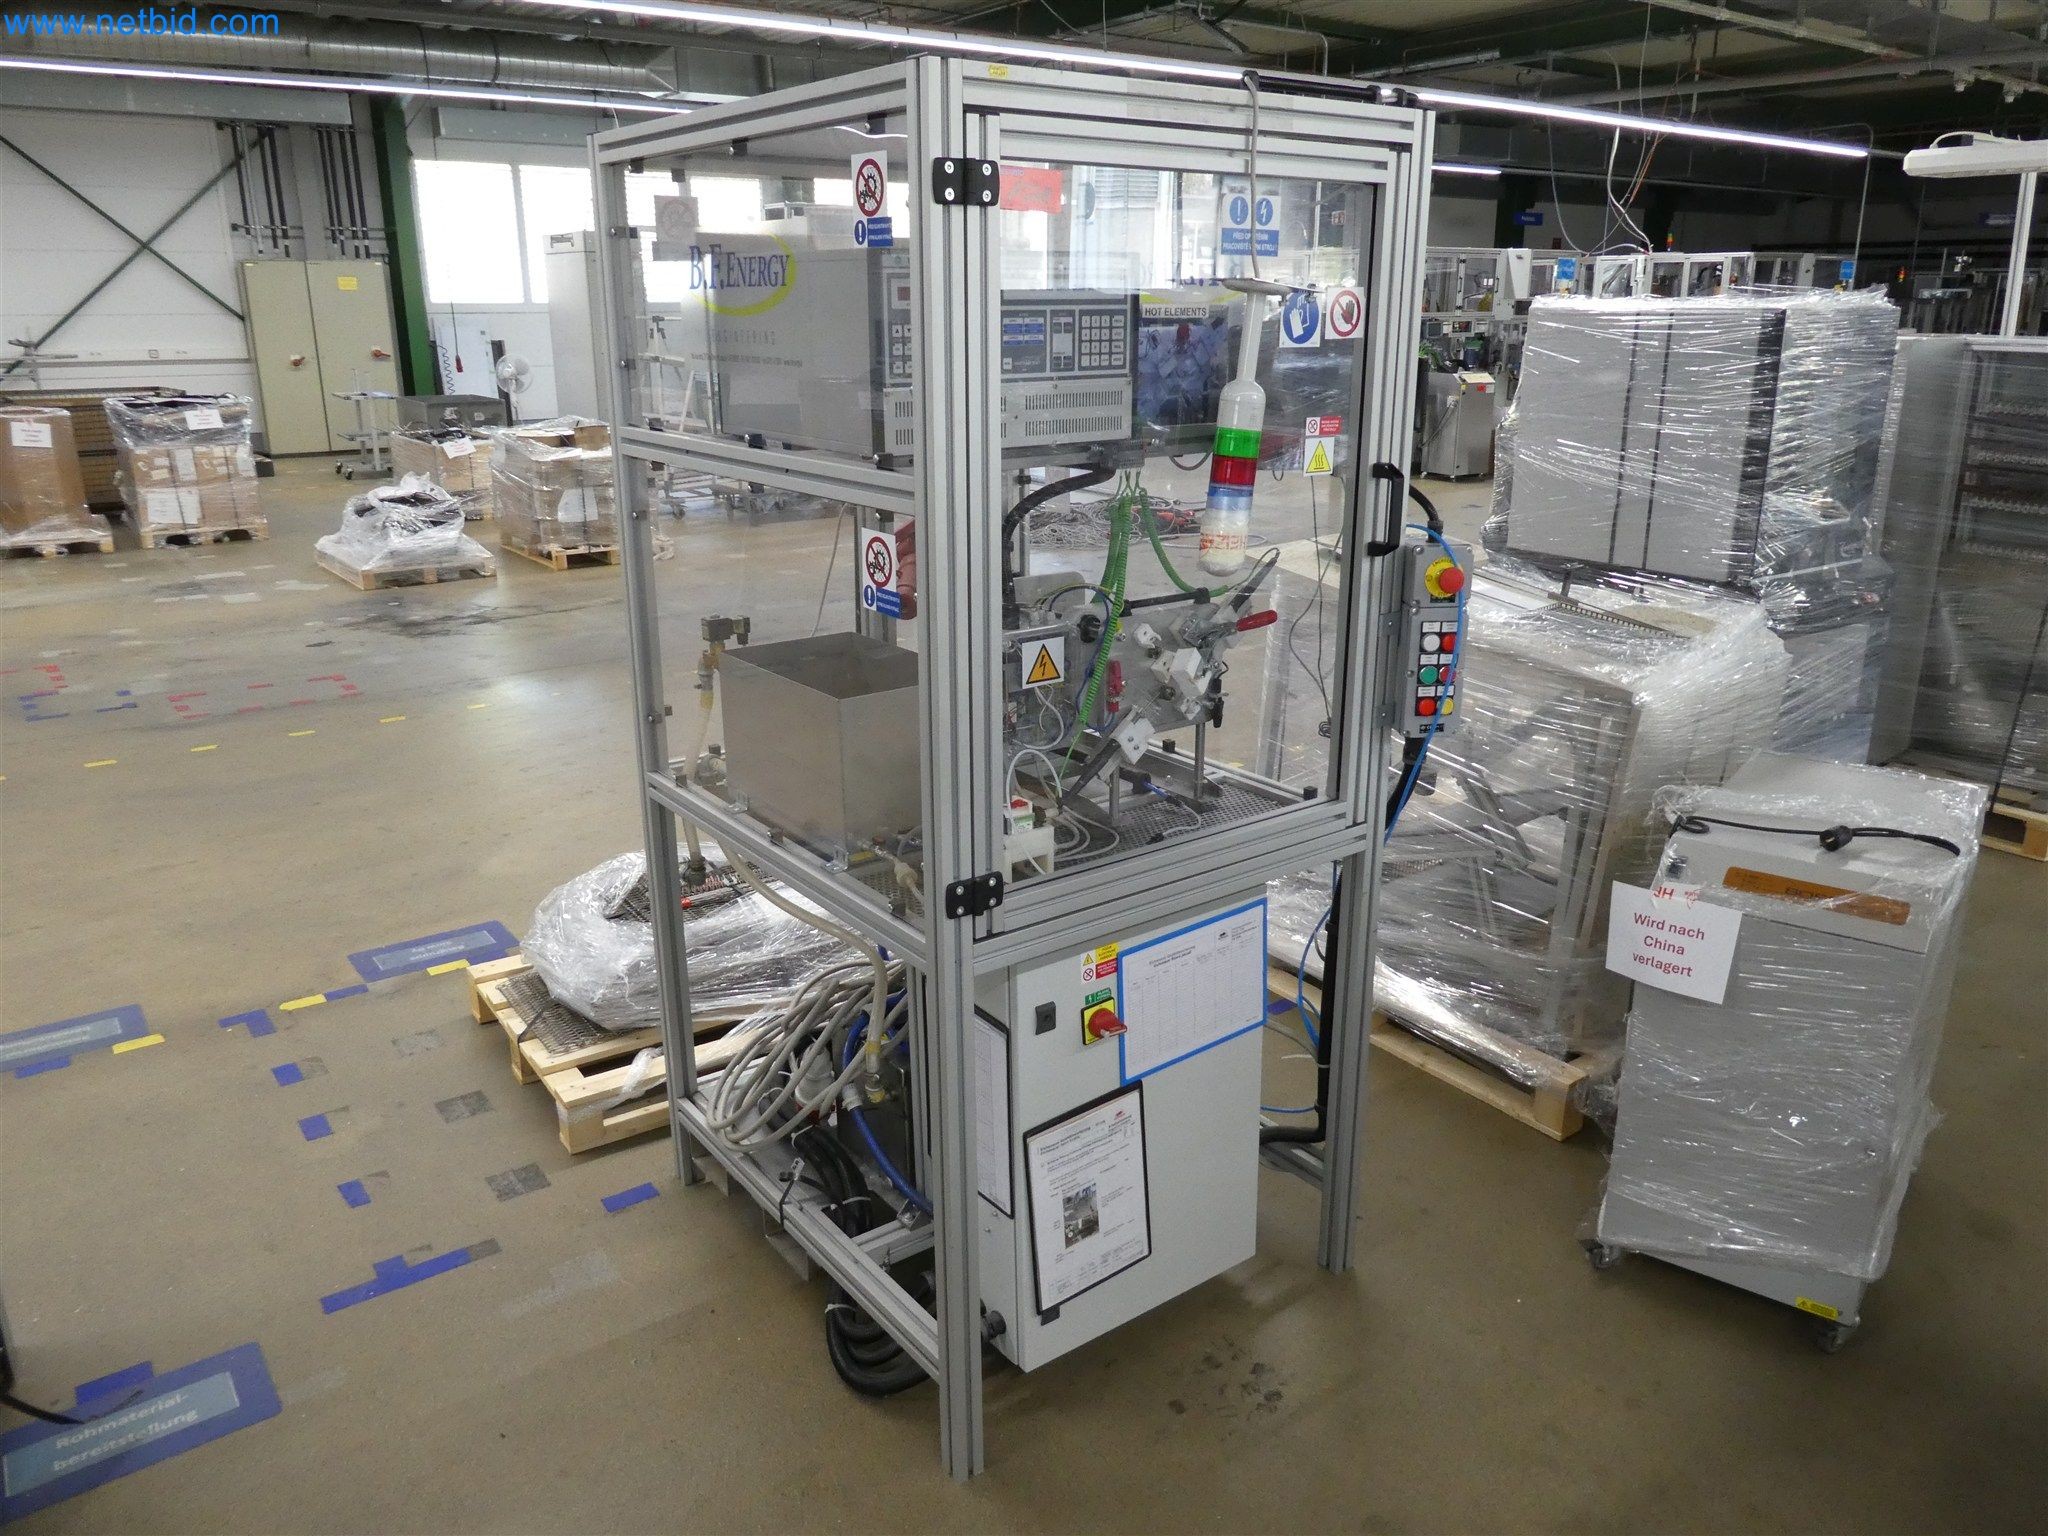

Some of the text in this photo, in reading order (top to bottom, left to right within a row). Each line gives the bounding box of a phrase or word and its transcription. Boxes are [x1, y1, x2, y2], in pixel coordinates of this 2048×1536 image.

[1144, 307, 1207, 317] HOT ELEMENTS
[1634, 912, 1705, 941] Wird nach
[1643, 934, 1685, 956] China
[1632, 952, 1693, 978] verlagert
[54, 1408, 199, 1472] bereitstellung
